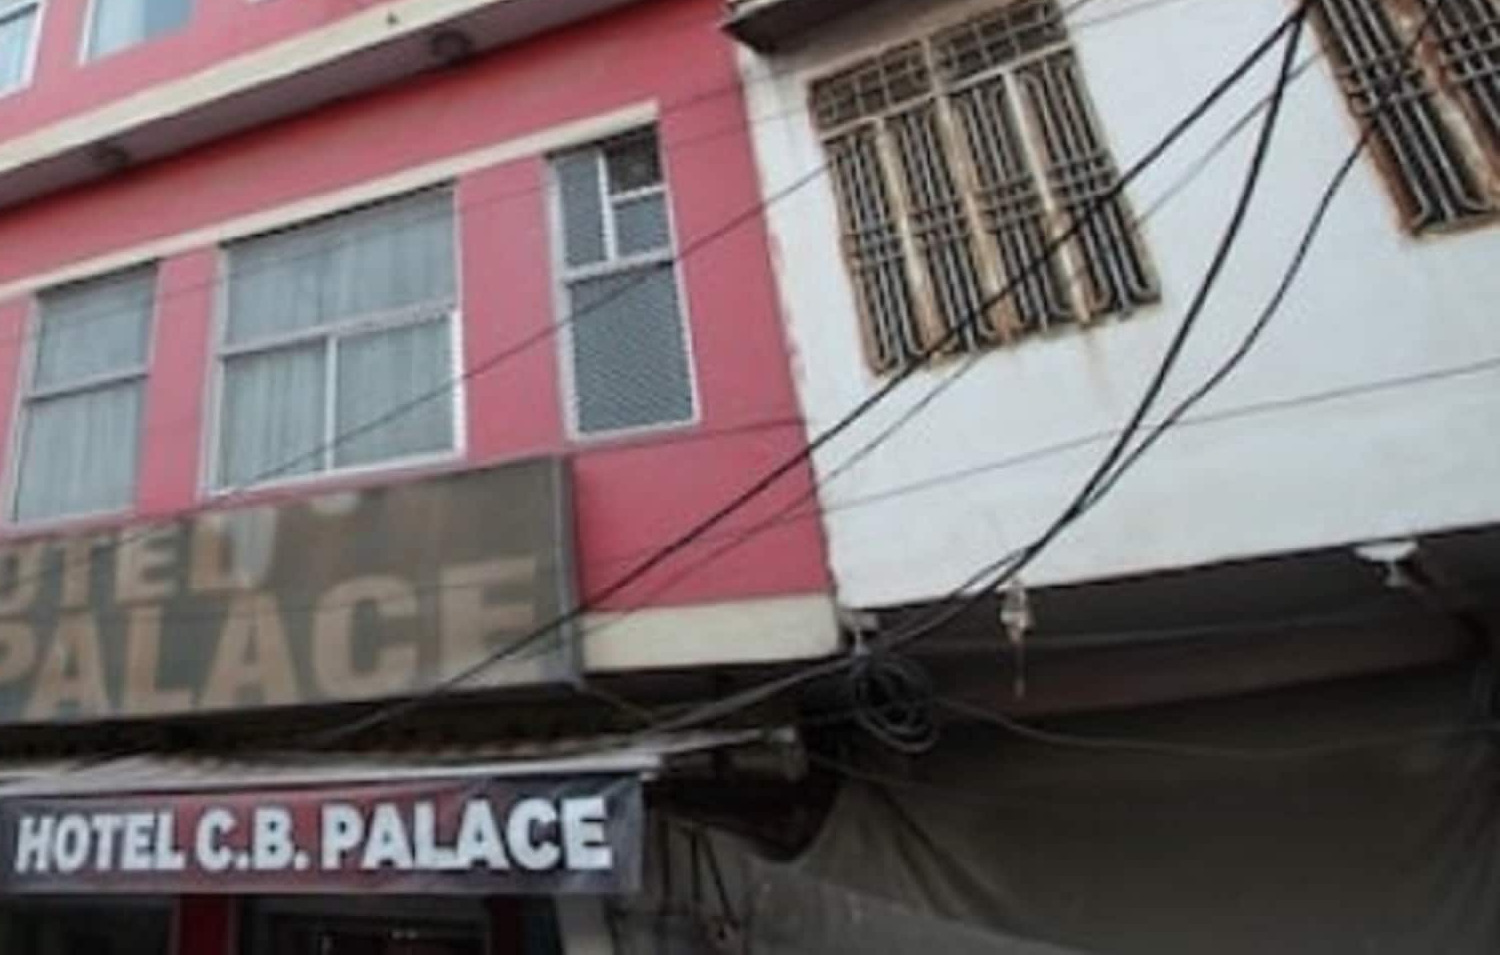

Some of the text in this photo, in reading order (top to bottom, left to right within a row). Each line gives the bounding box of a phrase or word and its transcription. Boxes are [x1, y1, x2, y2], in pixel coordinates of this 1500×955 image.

[15, 795, 613, 873] HOTEL C.B. PALACE
